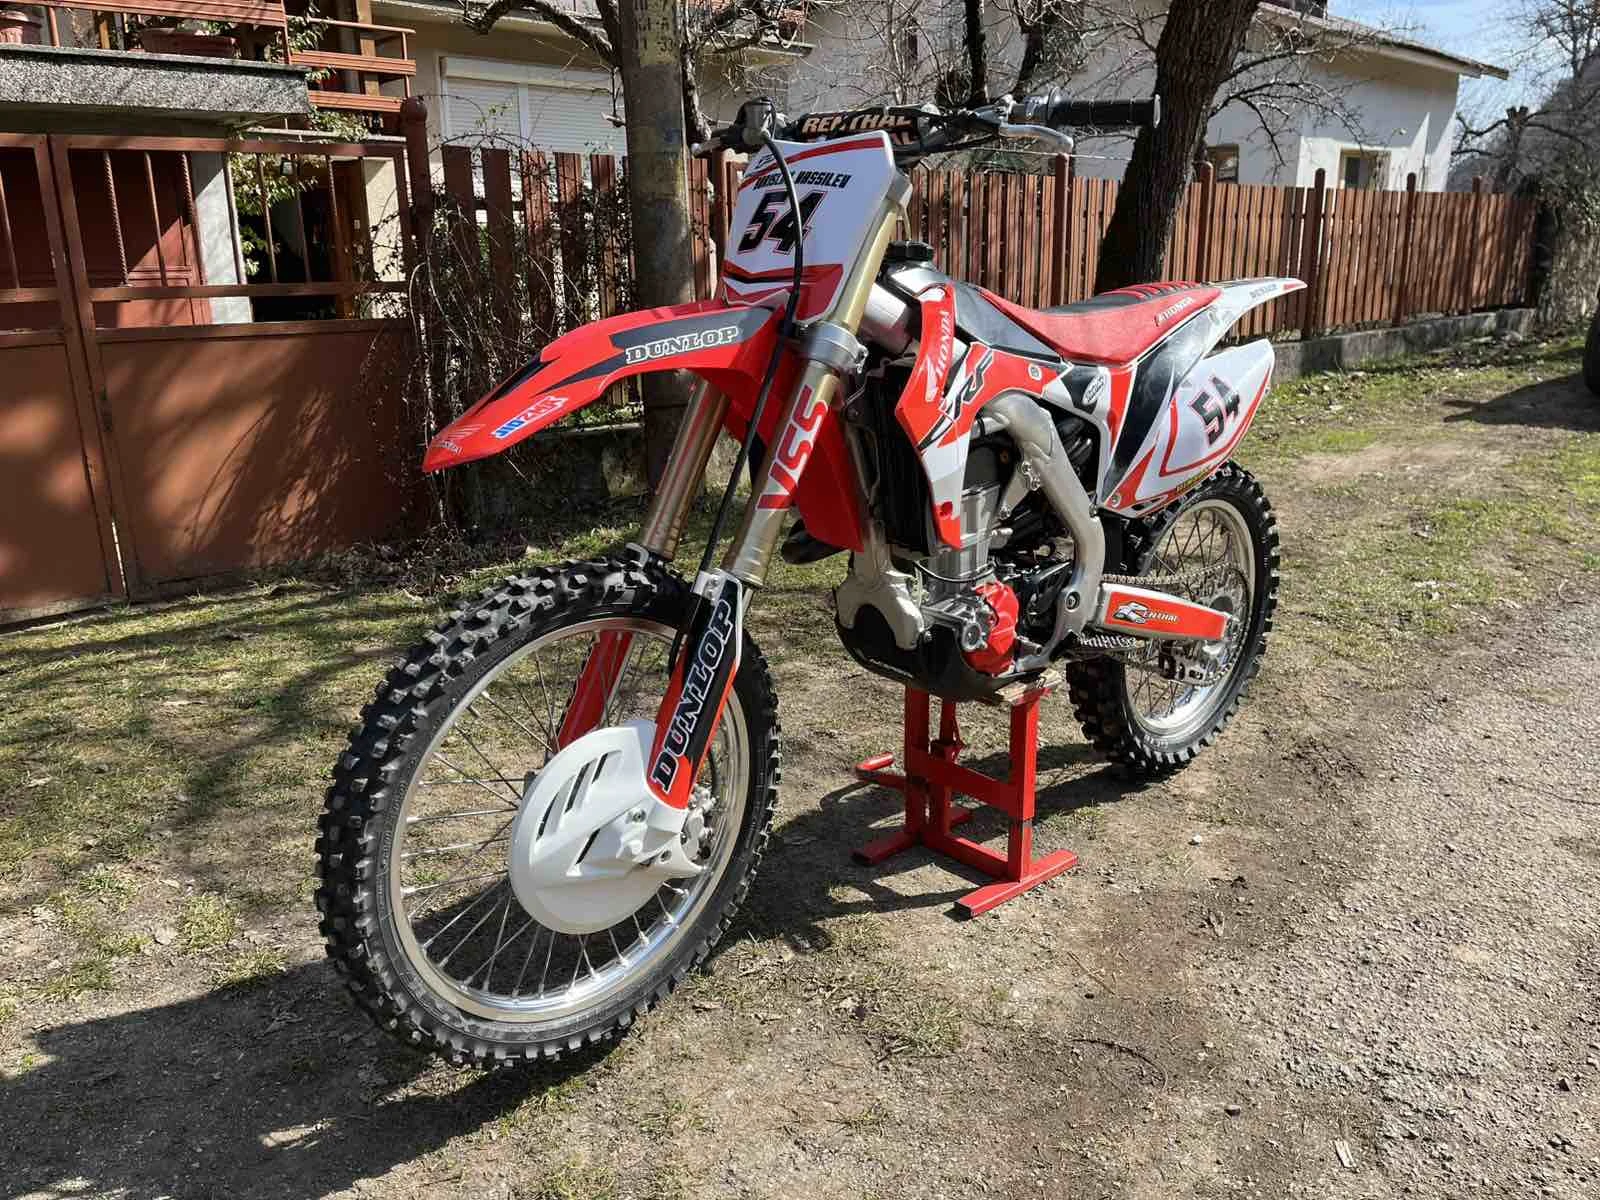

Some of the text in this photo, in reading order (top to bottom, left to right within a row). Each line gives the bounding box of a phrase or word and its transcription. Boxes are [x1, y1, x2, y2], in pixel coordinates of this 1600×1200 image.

[737, 189, 828, 255] 54
[625, 326, 740, 365] DUNLOP
[935, 309, 953, 378] HONDA
[1191, 376, 1240, 446] 54
[651, 599, 735, 795] DUNLOP
